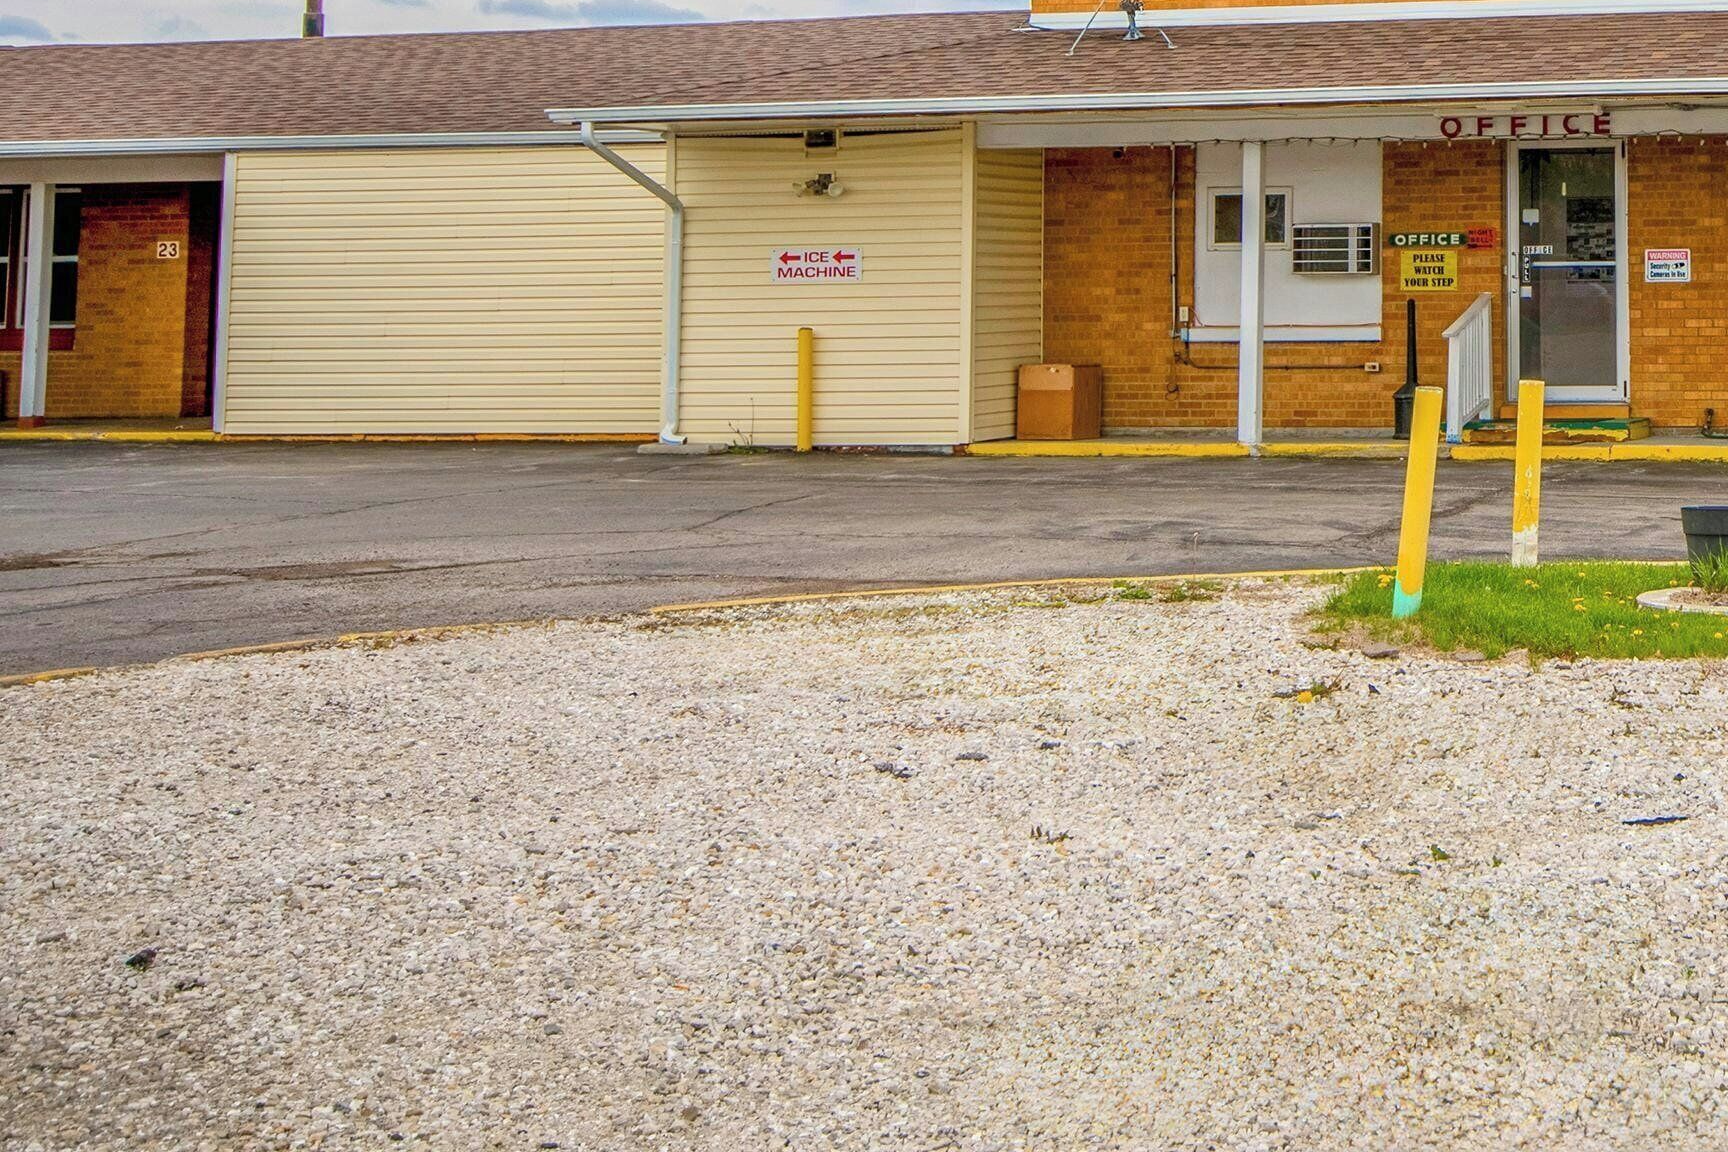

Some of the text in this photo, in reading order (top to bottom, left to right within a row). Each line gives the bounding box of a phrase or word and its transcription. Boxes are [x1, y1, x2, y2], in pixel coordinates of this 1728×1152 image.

[1440, 113, 1611, 138] OFFICE
[1394, 233, 1460, 246] OFFICE
[159, 242, 177, 257] 23
[804, 251, 829, 263] ICE
[1413, 253, 1446, 263] PLEASE
[1649, 252, 1687, 260] WARNING
[1414, 265, 1445, 275] WATCH
[1650, 262, 1670, 270] Security
[777, 266, 856, 278] MACHINE
[1405, 277, 1454, 287] YOUR STEP
